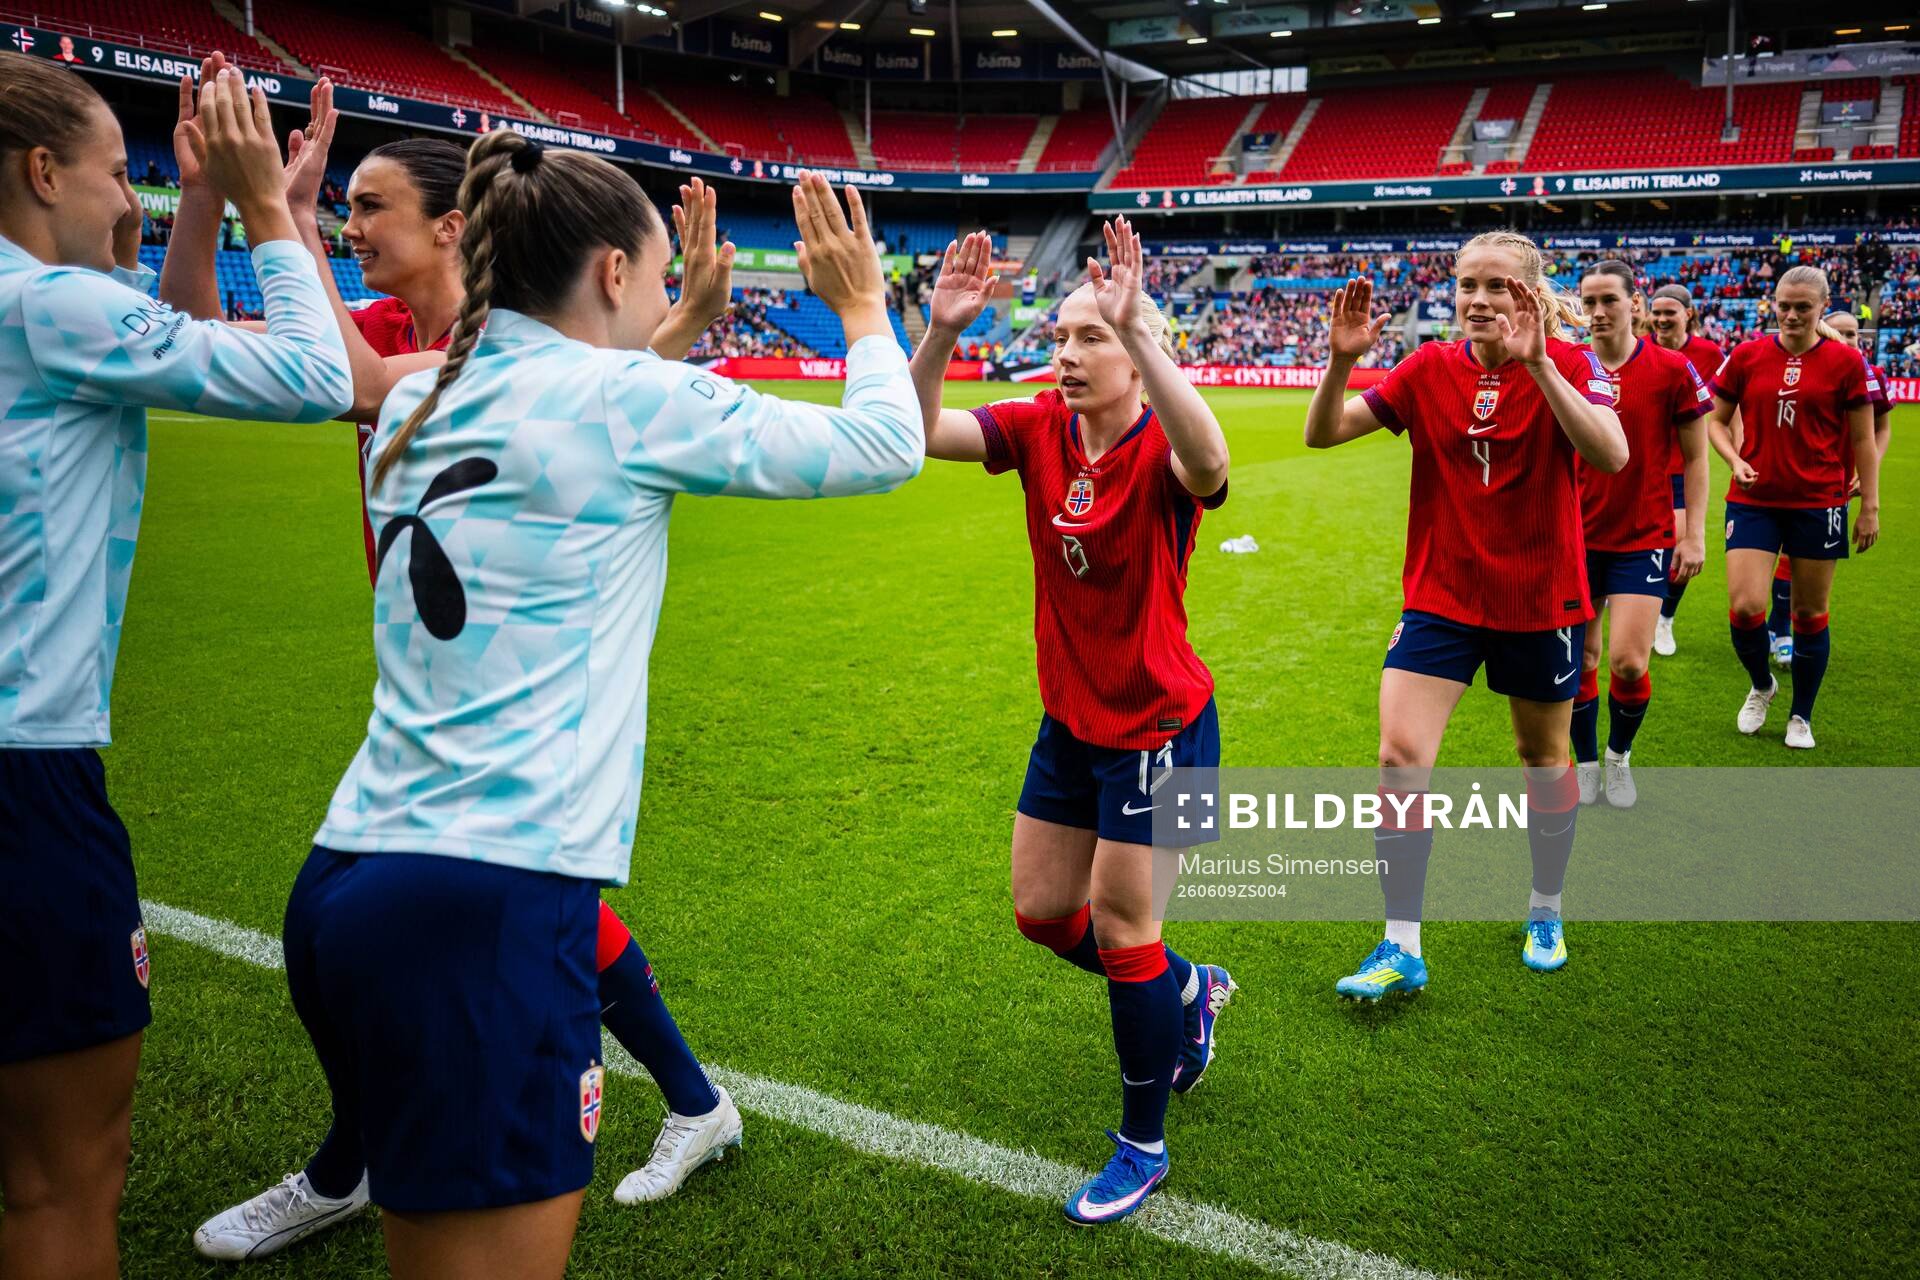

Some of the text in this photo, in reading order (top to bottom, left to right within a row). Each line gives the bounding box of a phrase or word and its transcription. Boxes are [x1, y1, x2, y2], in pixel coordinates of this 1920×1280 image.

[91, 46, 104, 63] 9
[1555, 173, 1721, 192] 9 ELISABETH TERLAND
[1814, 169, 1873, 181] Norsk Tipping
[1181, 188, 1313, 205] 9 ELISABETH TERLAND
[1777, 399, 1797, 430] 16
[1471, 440, 1490, 487] 4
[1556, 625, 1572, 664] 4
[1138, 740, 1173, 796] 13
